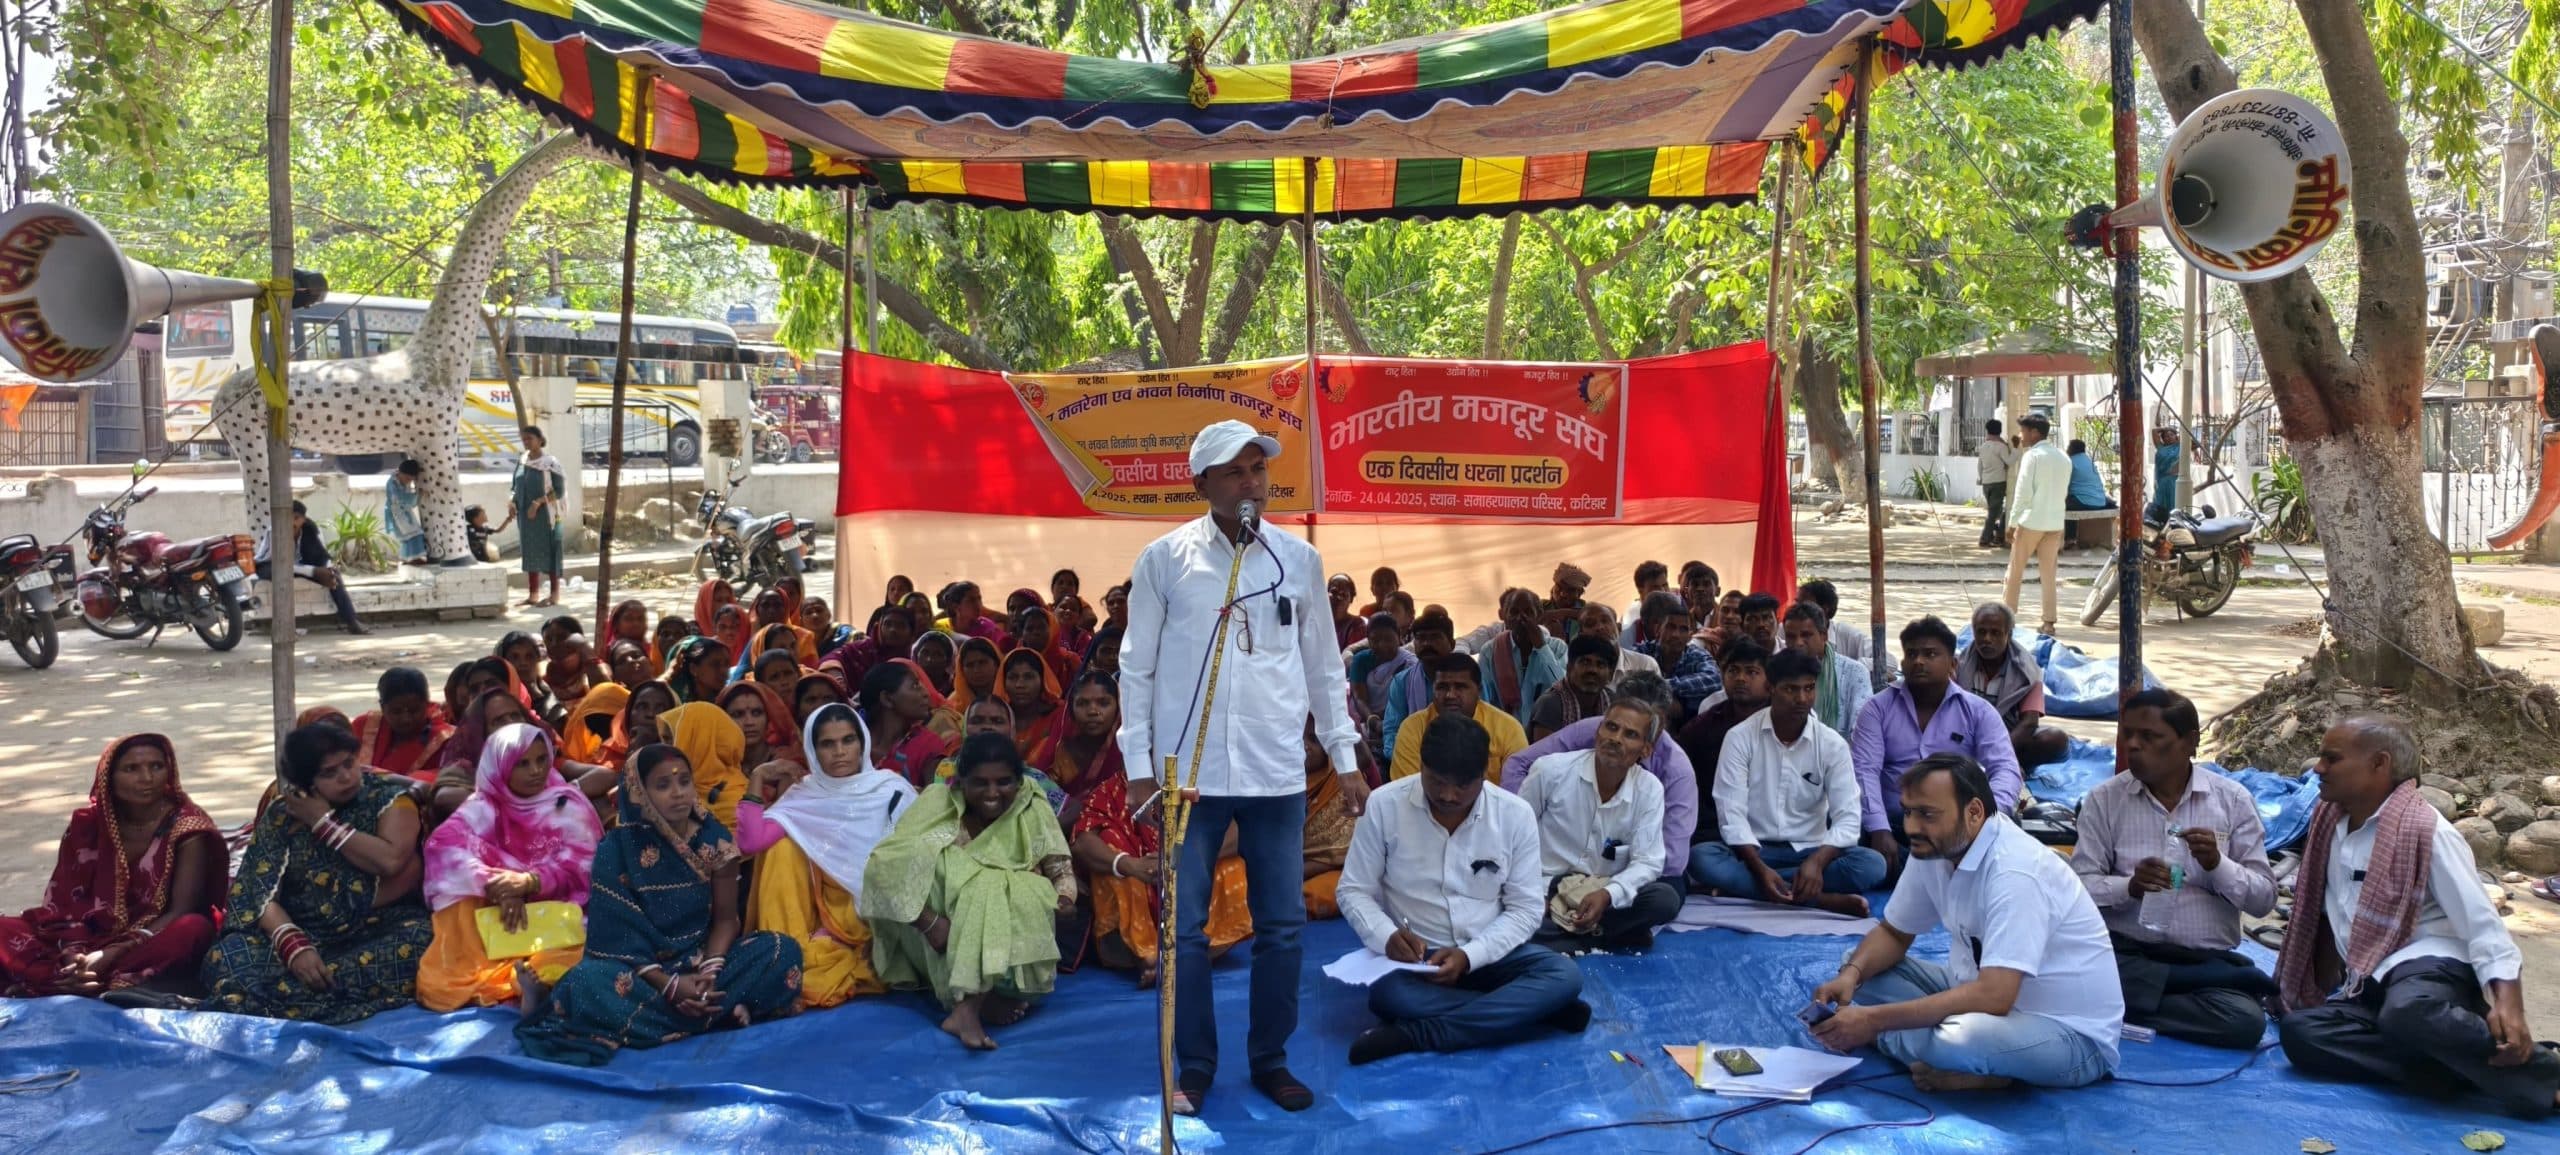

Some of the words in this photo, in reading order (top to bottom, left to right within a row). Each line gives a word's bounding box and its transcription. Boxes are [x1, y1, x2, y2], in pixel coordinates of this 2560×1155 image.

[1057, 392, 1108, 421] मनरेगा
[1136, 386, 1173, 399] भवन
[1177, 382, 1225, 402] निर्माण
[1230, 390, 1275, 419] मजदूर
[1278, 407, 1303, 431] संघ
[1329, 389, 1443, 450] भारतीय
[1452, 395, 1548, 440] मजदूर
[1555, 410, 1608, 462] संघ
[1111, 434, 1138, 449] निर्माण
[1365, 460, 1395, 479] एक
[1399, 455, 1460, 482] दिवसीय
[1464, 462, 1507, 483] धरना
[1511, 458, 1562, 485] प्रदर्शन
[1463, 494, 1529, 509] समाहरणालय
[1569, 493, 1608, 510] कटिहार
